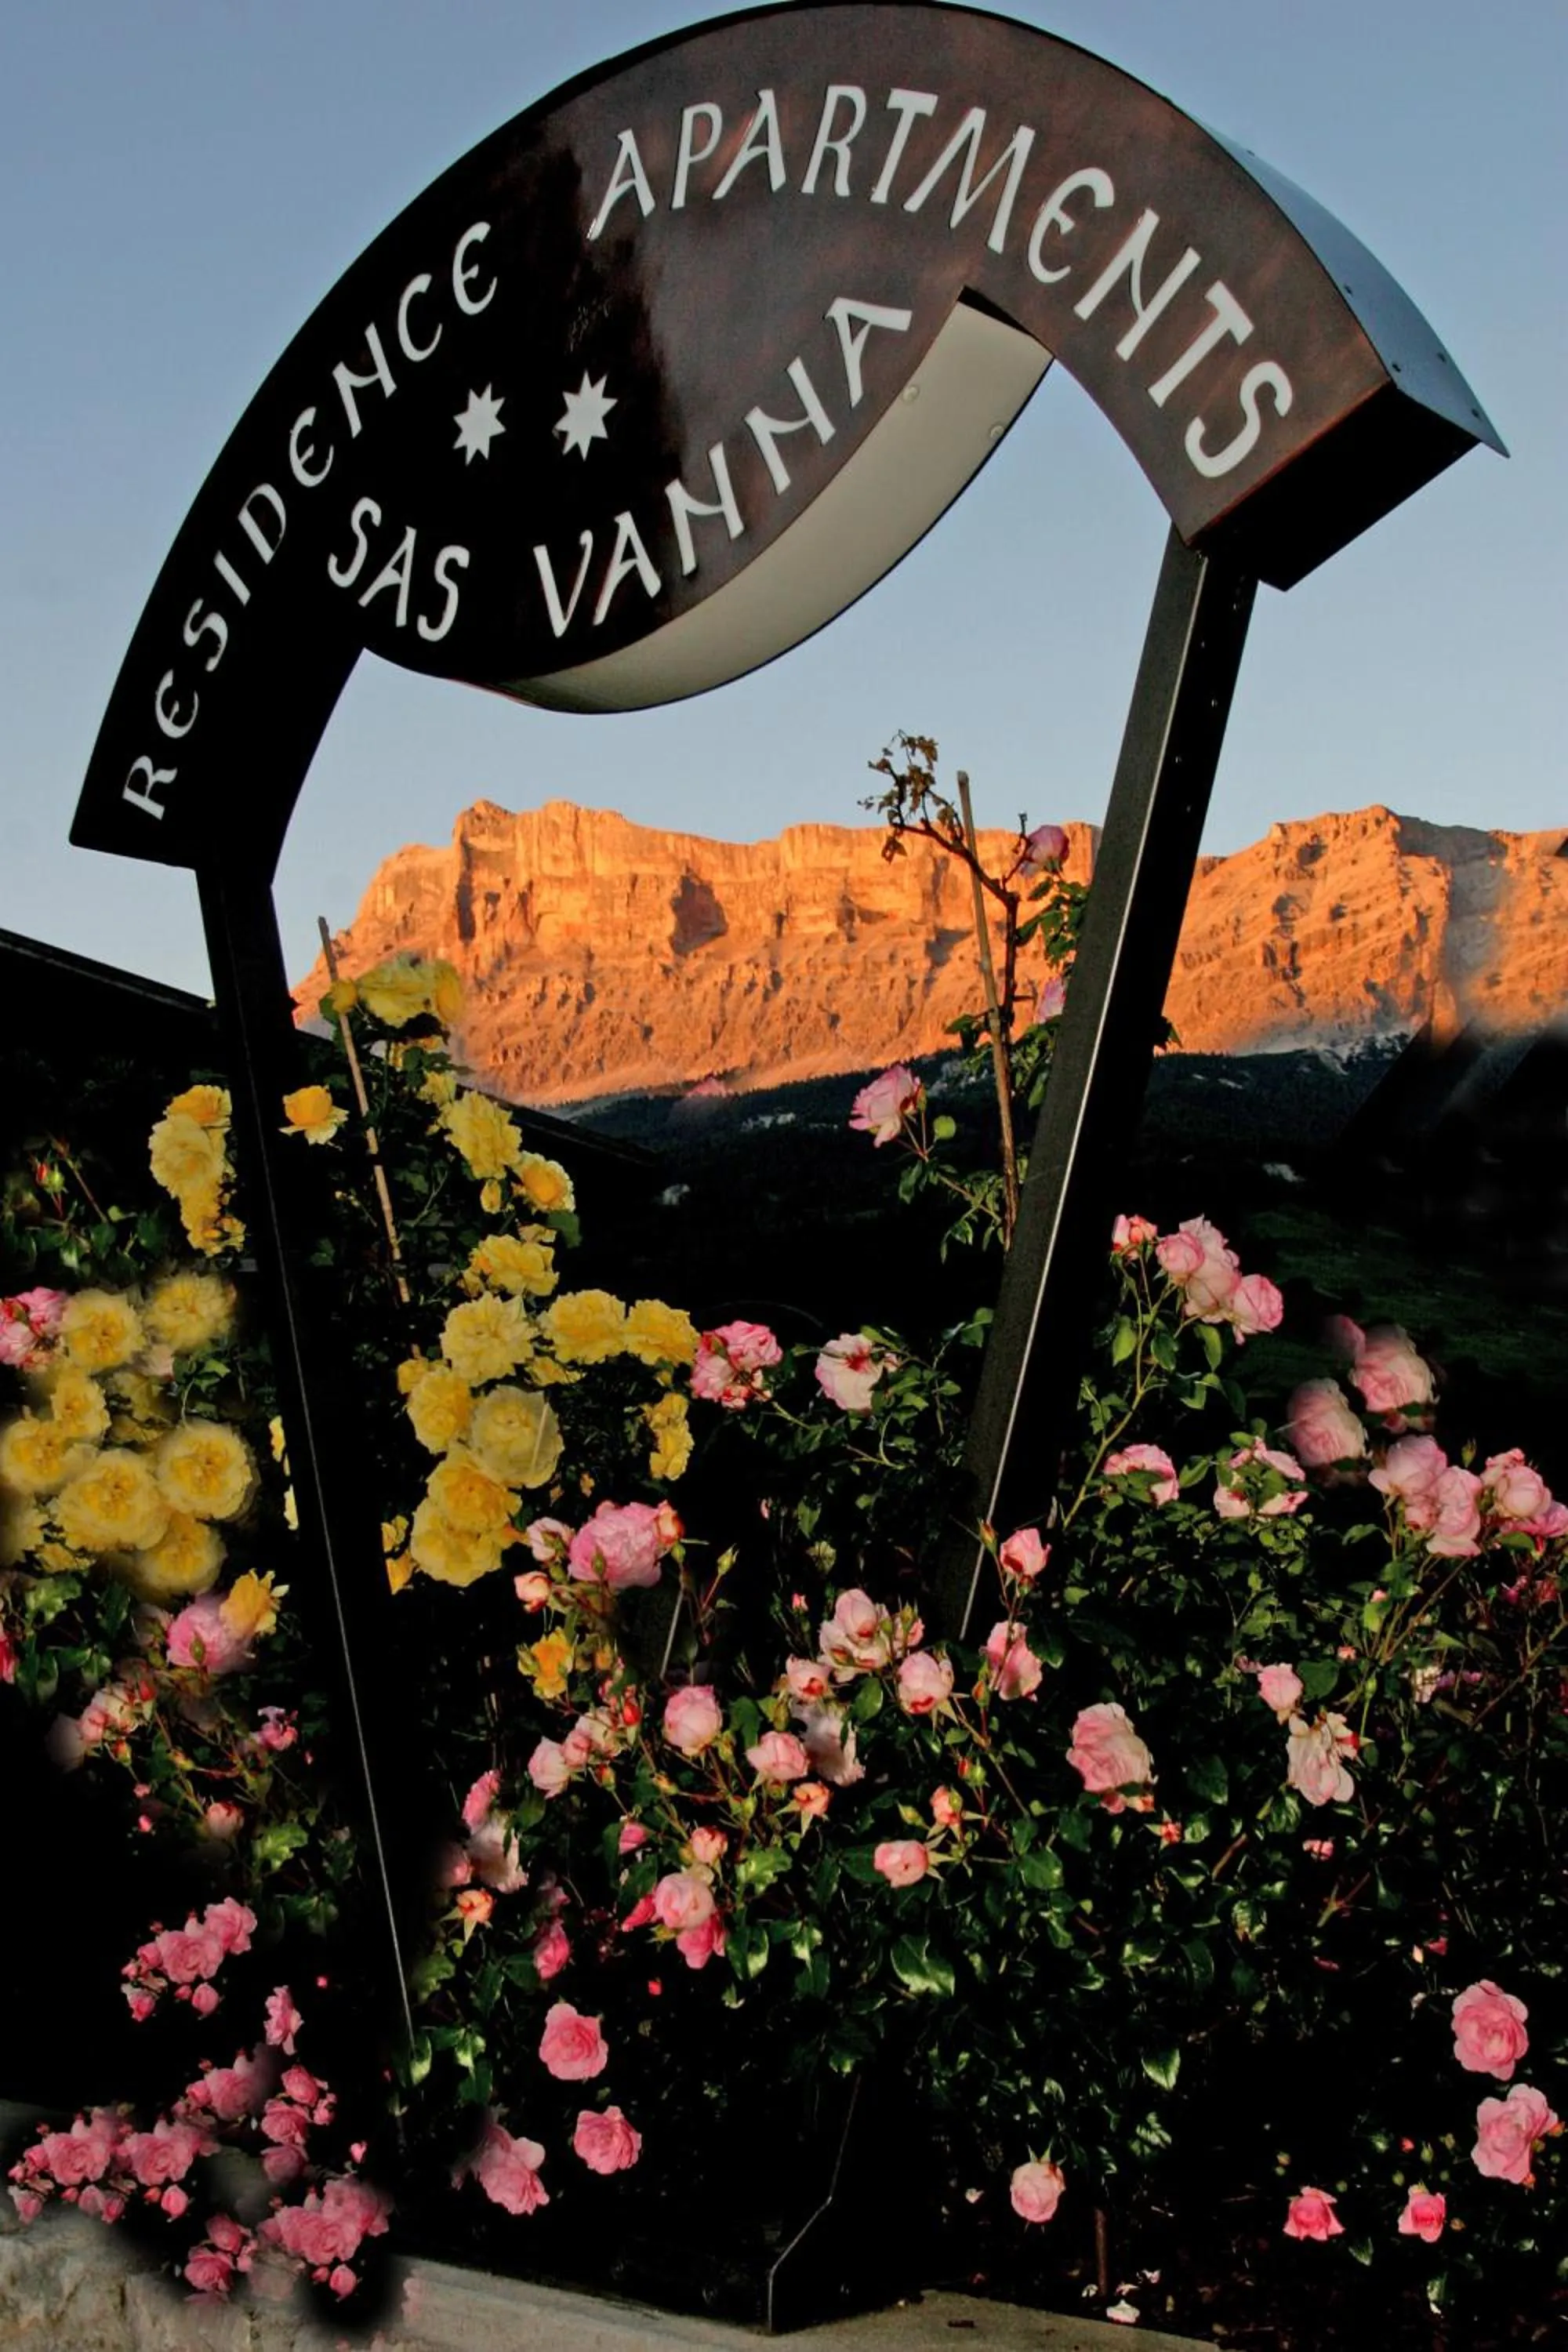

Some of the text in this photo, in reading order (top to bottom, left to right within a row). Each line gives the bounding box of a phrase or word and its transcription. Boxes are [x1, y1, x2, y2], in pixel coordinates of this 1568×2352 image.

[122, 84, 1294, 821] RESIDENCE APARTMENTS
[326, 296, 913, 643] SAS VANNA
